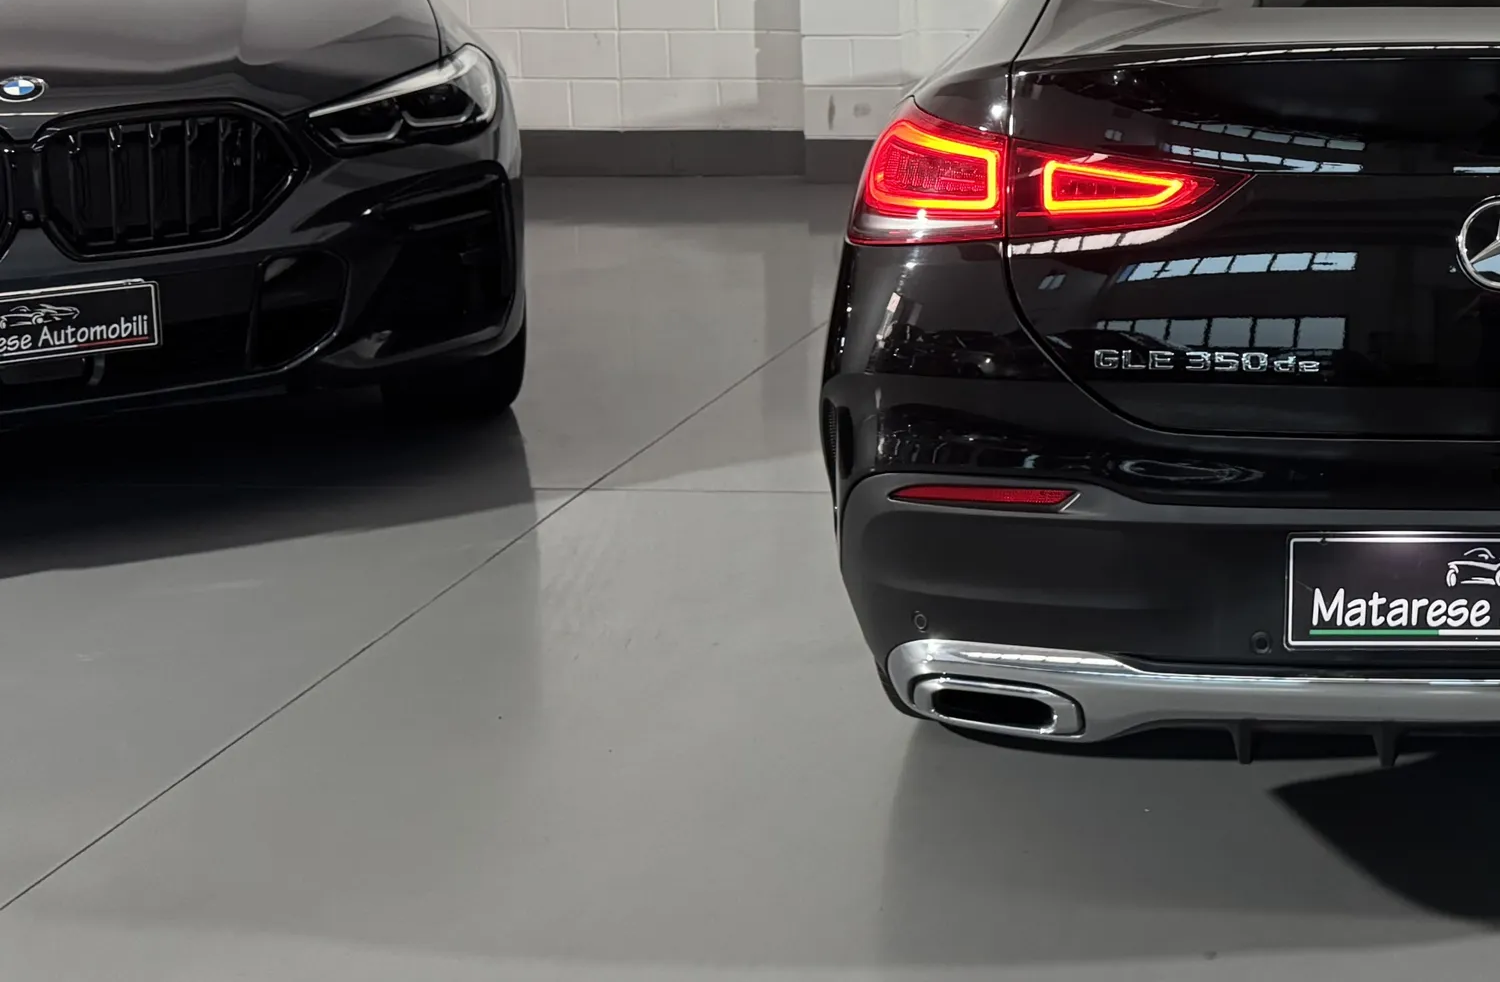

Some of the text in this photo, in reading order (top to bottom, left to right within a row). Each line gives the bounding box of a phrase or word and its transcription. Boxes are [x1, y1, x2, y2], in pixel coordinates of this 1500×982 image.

[37, 314, 149, 349] Automobili
[1094, 349, 1175, 371] GLE
[1311, 587, 1492, 628] Matarese
